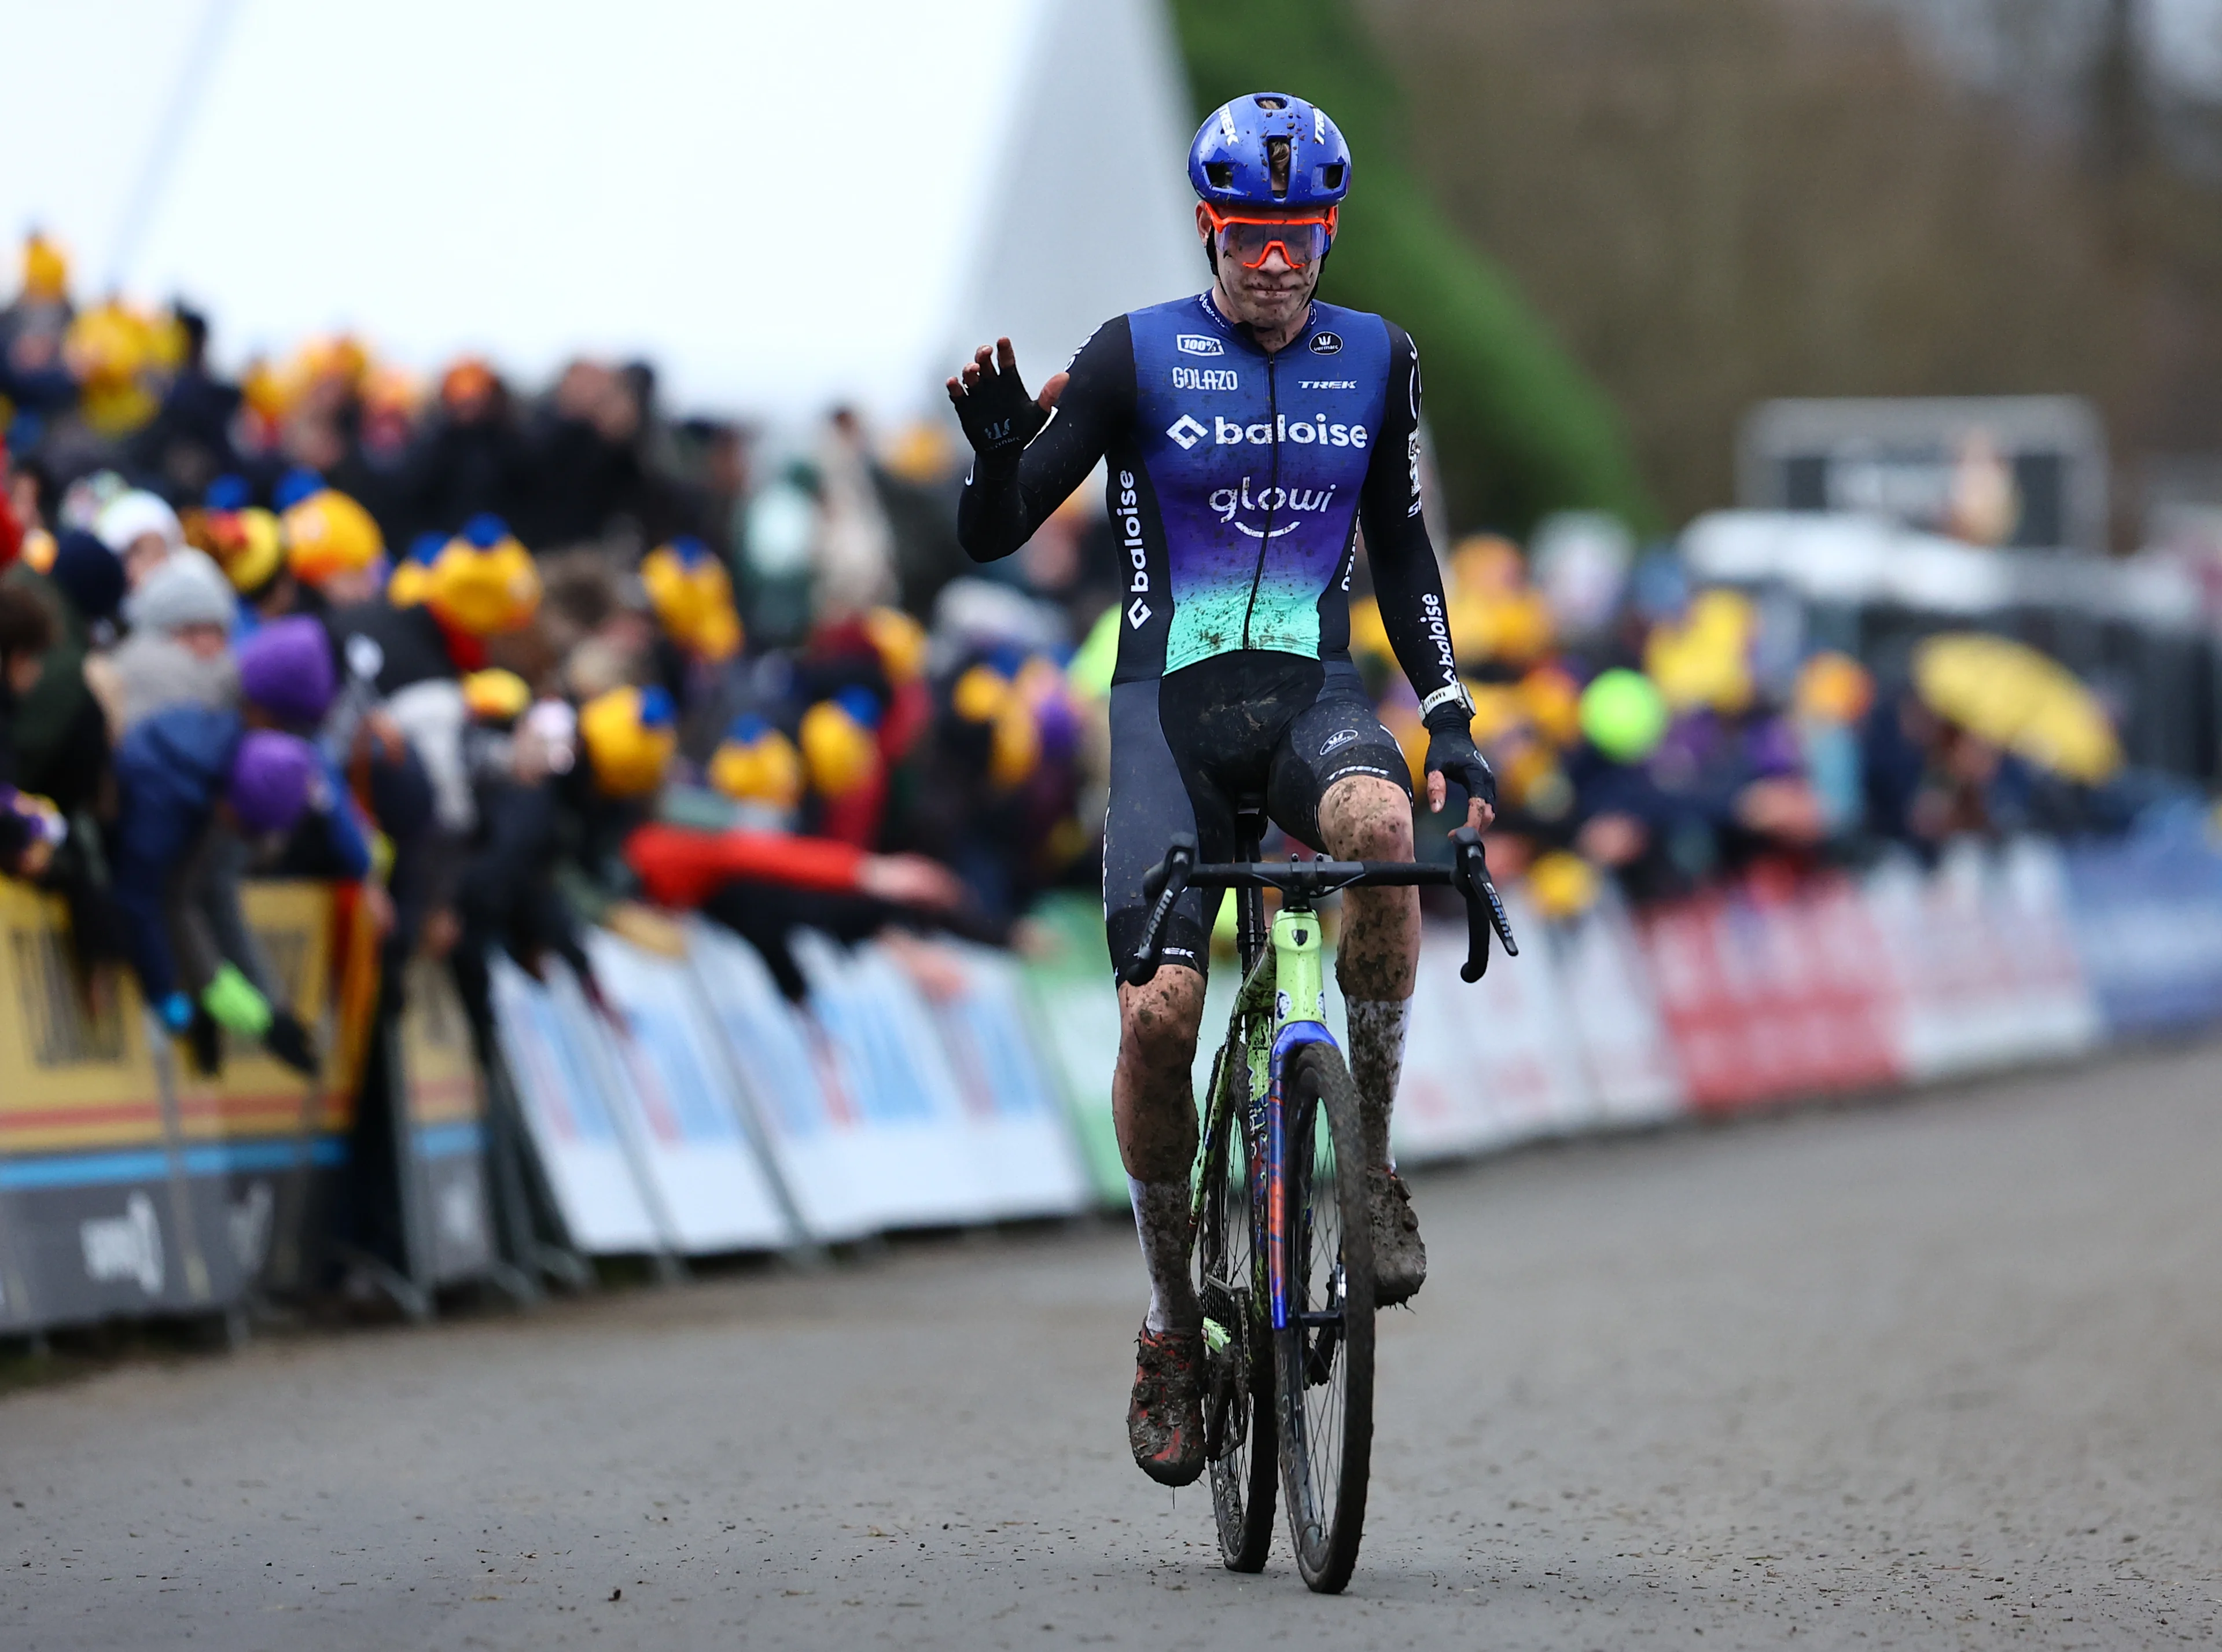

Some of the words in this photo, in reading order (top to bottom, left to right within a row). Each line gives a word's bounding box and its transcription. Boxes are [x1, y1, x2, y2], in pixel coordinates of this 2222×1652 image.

[1217, 102, 1239, 147] TREK
[1183, 339, 1216, 352] 100%
[1172, 366, 1238, 391] GOLAZO
[1298, 380, 1358, 389] TREK
[1215, 413, 1368, 448] baloise
[1209, 476, 1336, 523] glowi
[1116, 470, 1149, 593] baloise
[1419, 593, 1455, 668] baloise
[1482, 882, 1513, 937] SRAM
